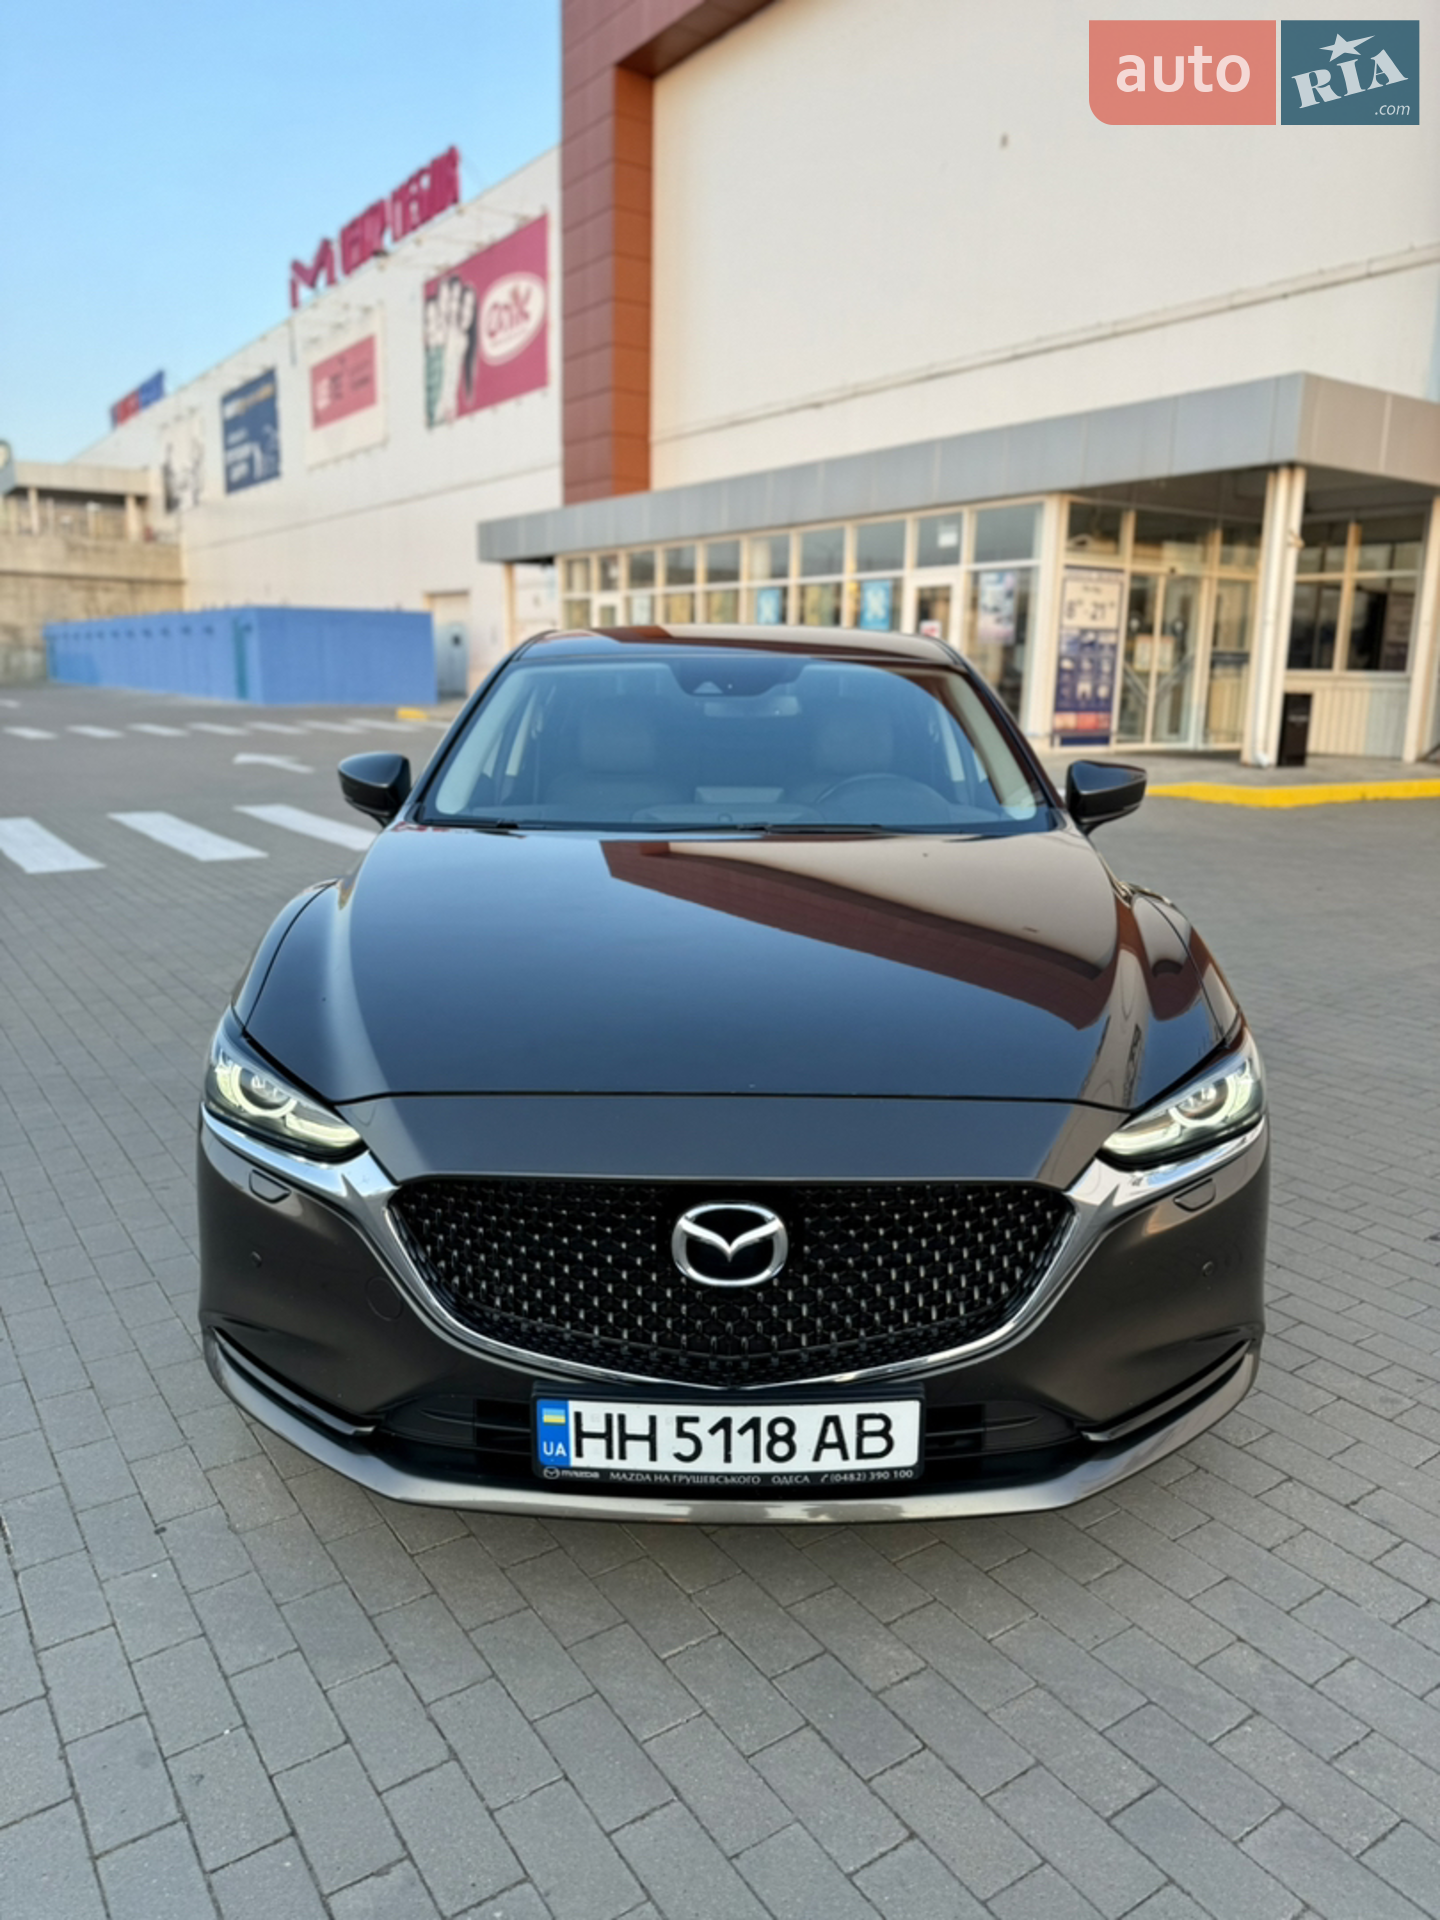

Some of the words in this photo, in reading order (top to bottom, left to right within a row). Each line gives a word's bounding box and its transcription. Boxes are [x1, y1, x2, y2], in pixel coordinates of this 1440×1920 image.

[573, 1411, 657, 1462] HH
[673, 1416, 797, 1464] 5118
[812, 1413, 895, 1462] AB
[542, 1442, 567, 1457] UA
[609, 1472, 651, 1482] MAZDA
[654, 1473, 671, 1483] НА
[771, 1475, 810, 1486] ОДЕСА
[869, 1471, 890, 1481] 390
[893, 1469, 914, 1479] 100
